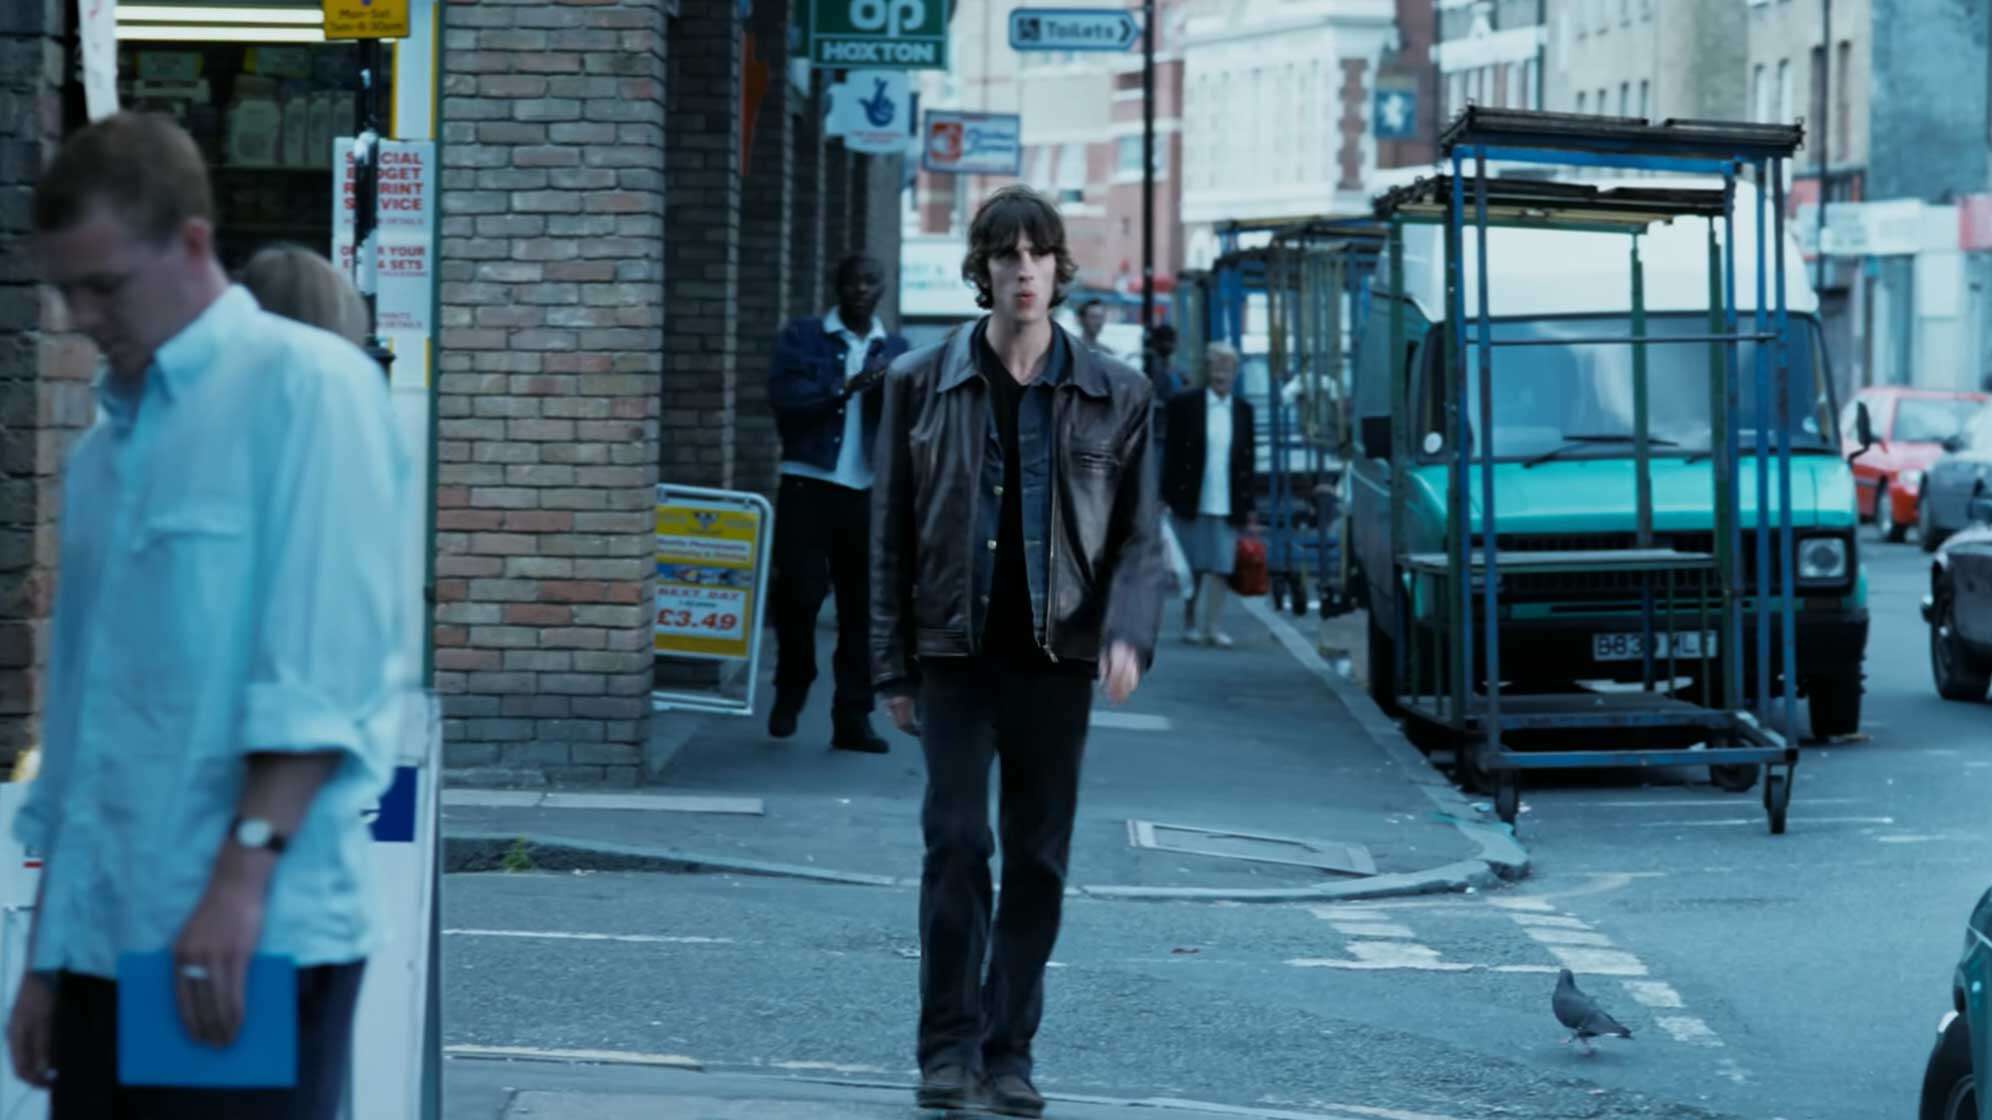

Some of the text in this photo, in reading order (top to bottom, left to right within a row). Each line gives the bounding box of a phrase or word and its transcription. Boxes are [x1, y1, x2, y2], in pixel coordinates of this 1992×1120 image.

[1047, 21, 1114, 39] Toilets
[823, 41, 934, 62] HOXTON
[345, 151, 423, 165] SCIAL
[343, 182, 423, 194] RRINT
[344, 197, 422, 210] SVICE
[390, 245, 424, 257] YOUR
[390, 259, 422, 270] SETS
[657, 608, 736, 630] £3.49
